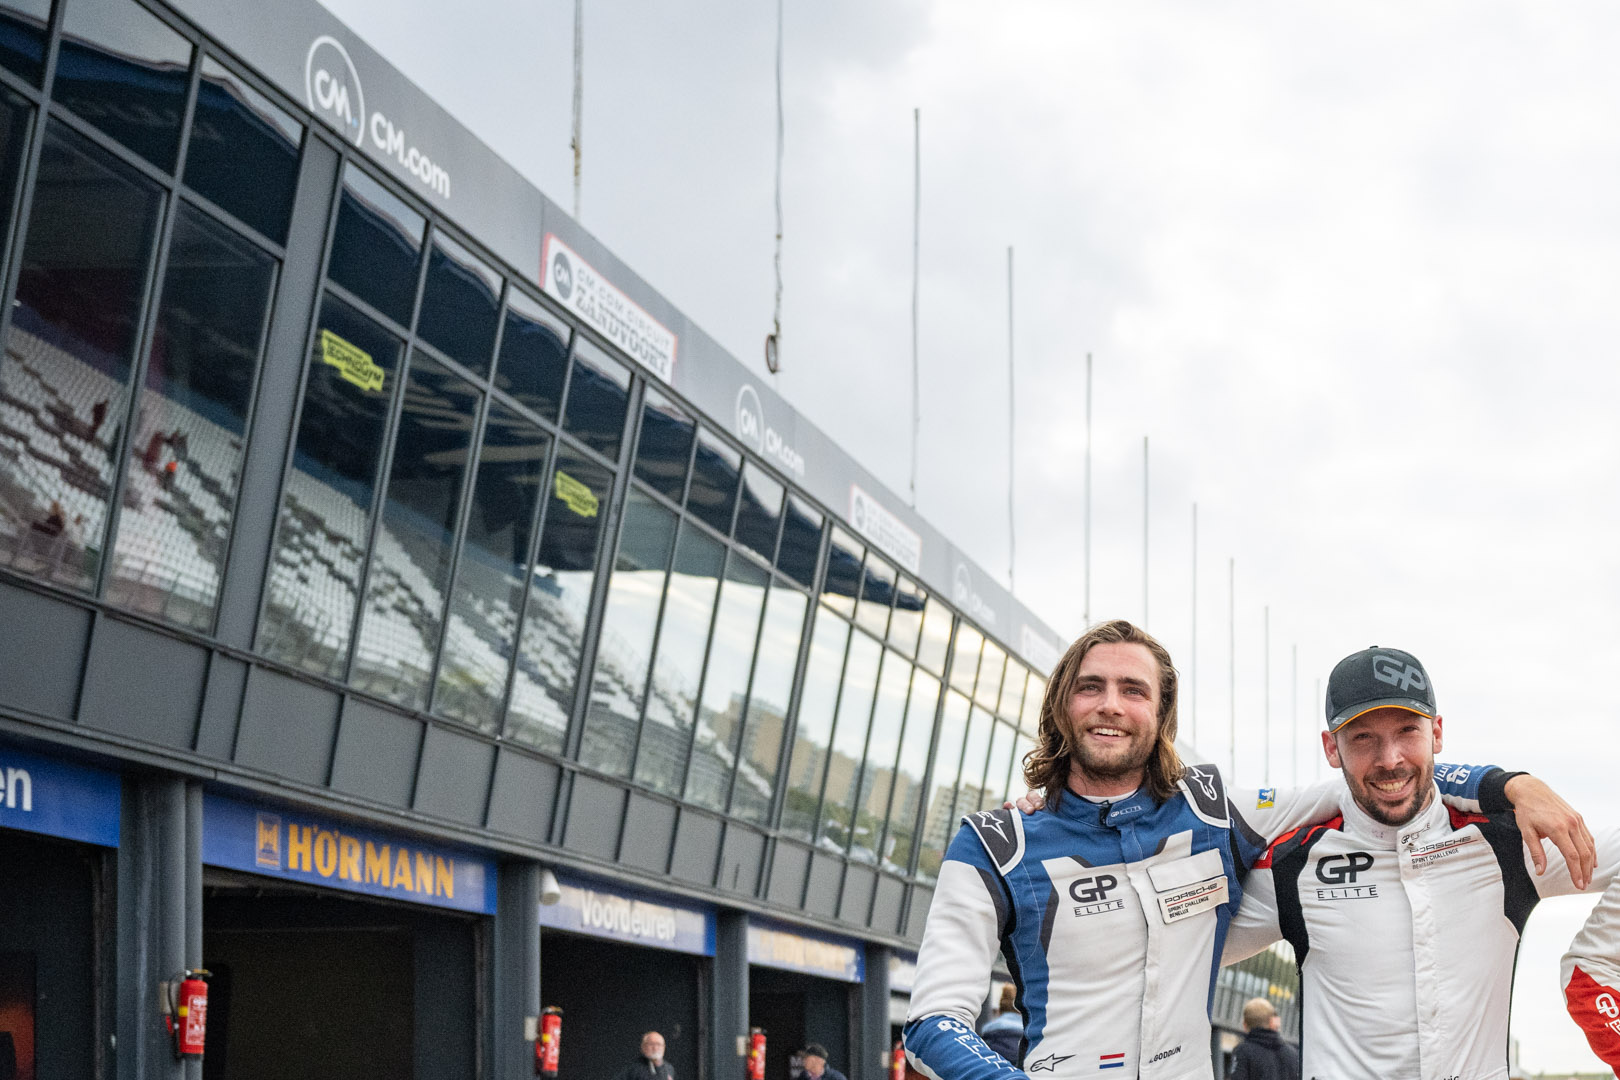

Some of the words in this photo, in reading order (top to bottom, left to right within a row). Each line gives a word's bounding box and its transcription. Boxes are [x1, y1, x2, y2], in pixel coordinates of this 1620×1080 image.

[370, 111, 450, 199] CM.com
[1372, 654, 1428, 692] GP
[287, 823, 455, 899] HÖRMANN
[1315, 851, 1375, 886] GP
[1429, 847, 1460, 861] CHALLENGE
[1069, 874, 1118, 904] GP
[1164, 882, 1219, 905] PORSCHE
[1316, 886, 1379, 900] ELITE
[1073, 900, 1126, 917] ELITE
